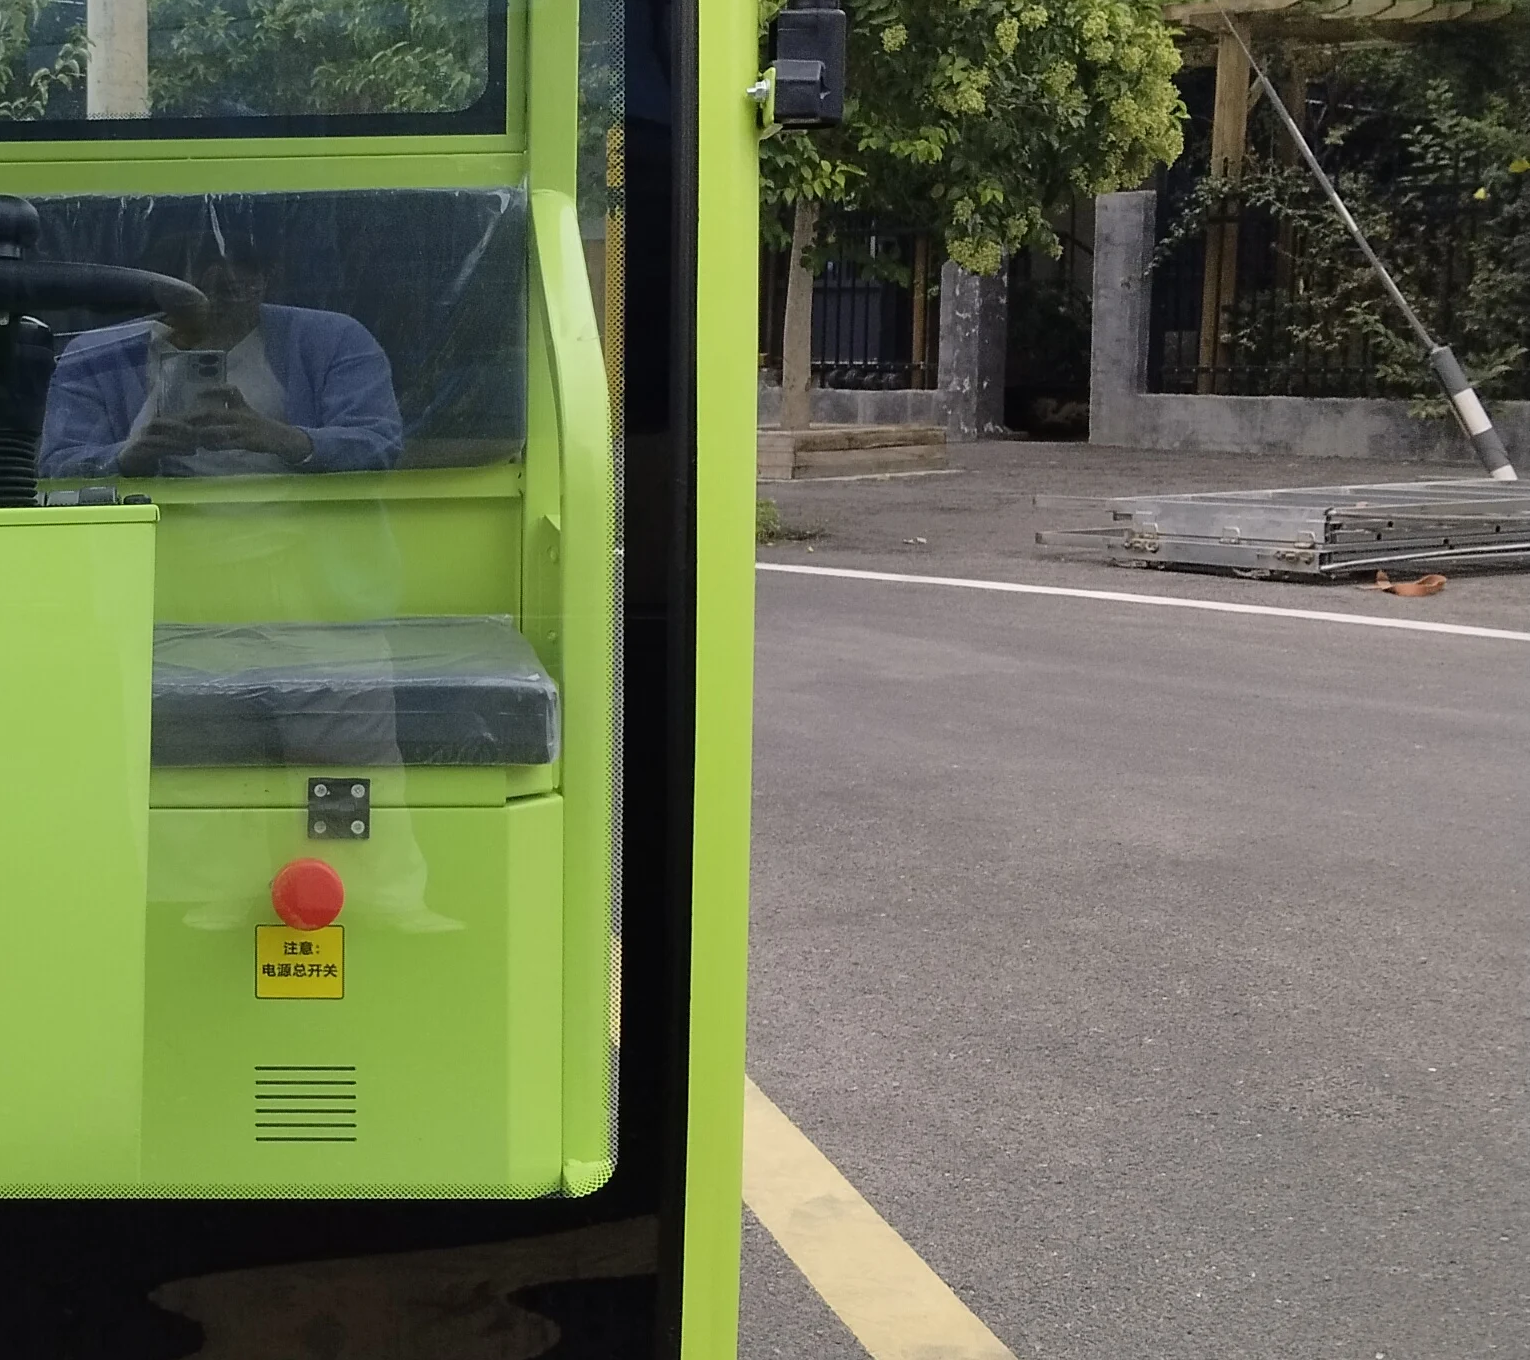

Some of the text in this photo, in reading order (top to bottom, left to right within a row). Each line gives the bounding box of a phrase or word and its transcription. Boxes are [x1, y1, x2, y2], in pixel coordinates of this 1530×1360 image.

[262, 963, 338, 977] 电源总开关
